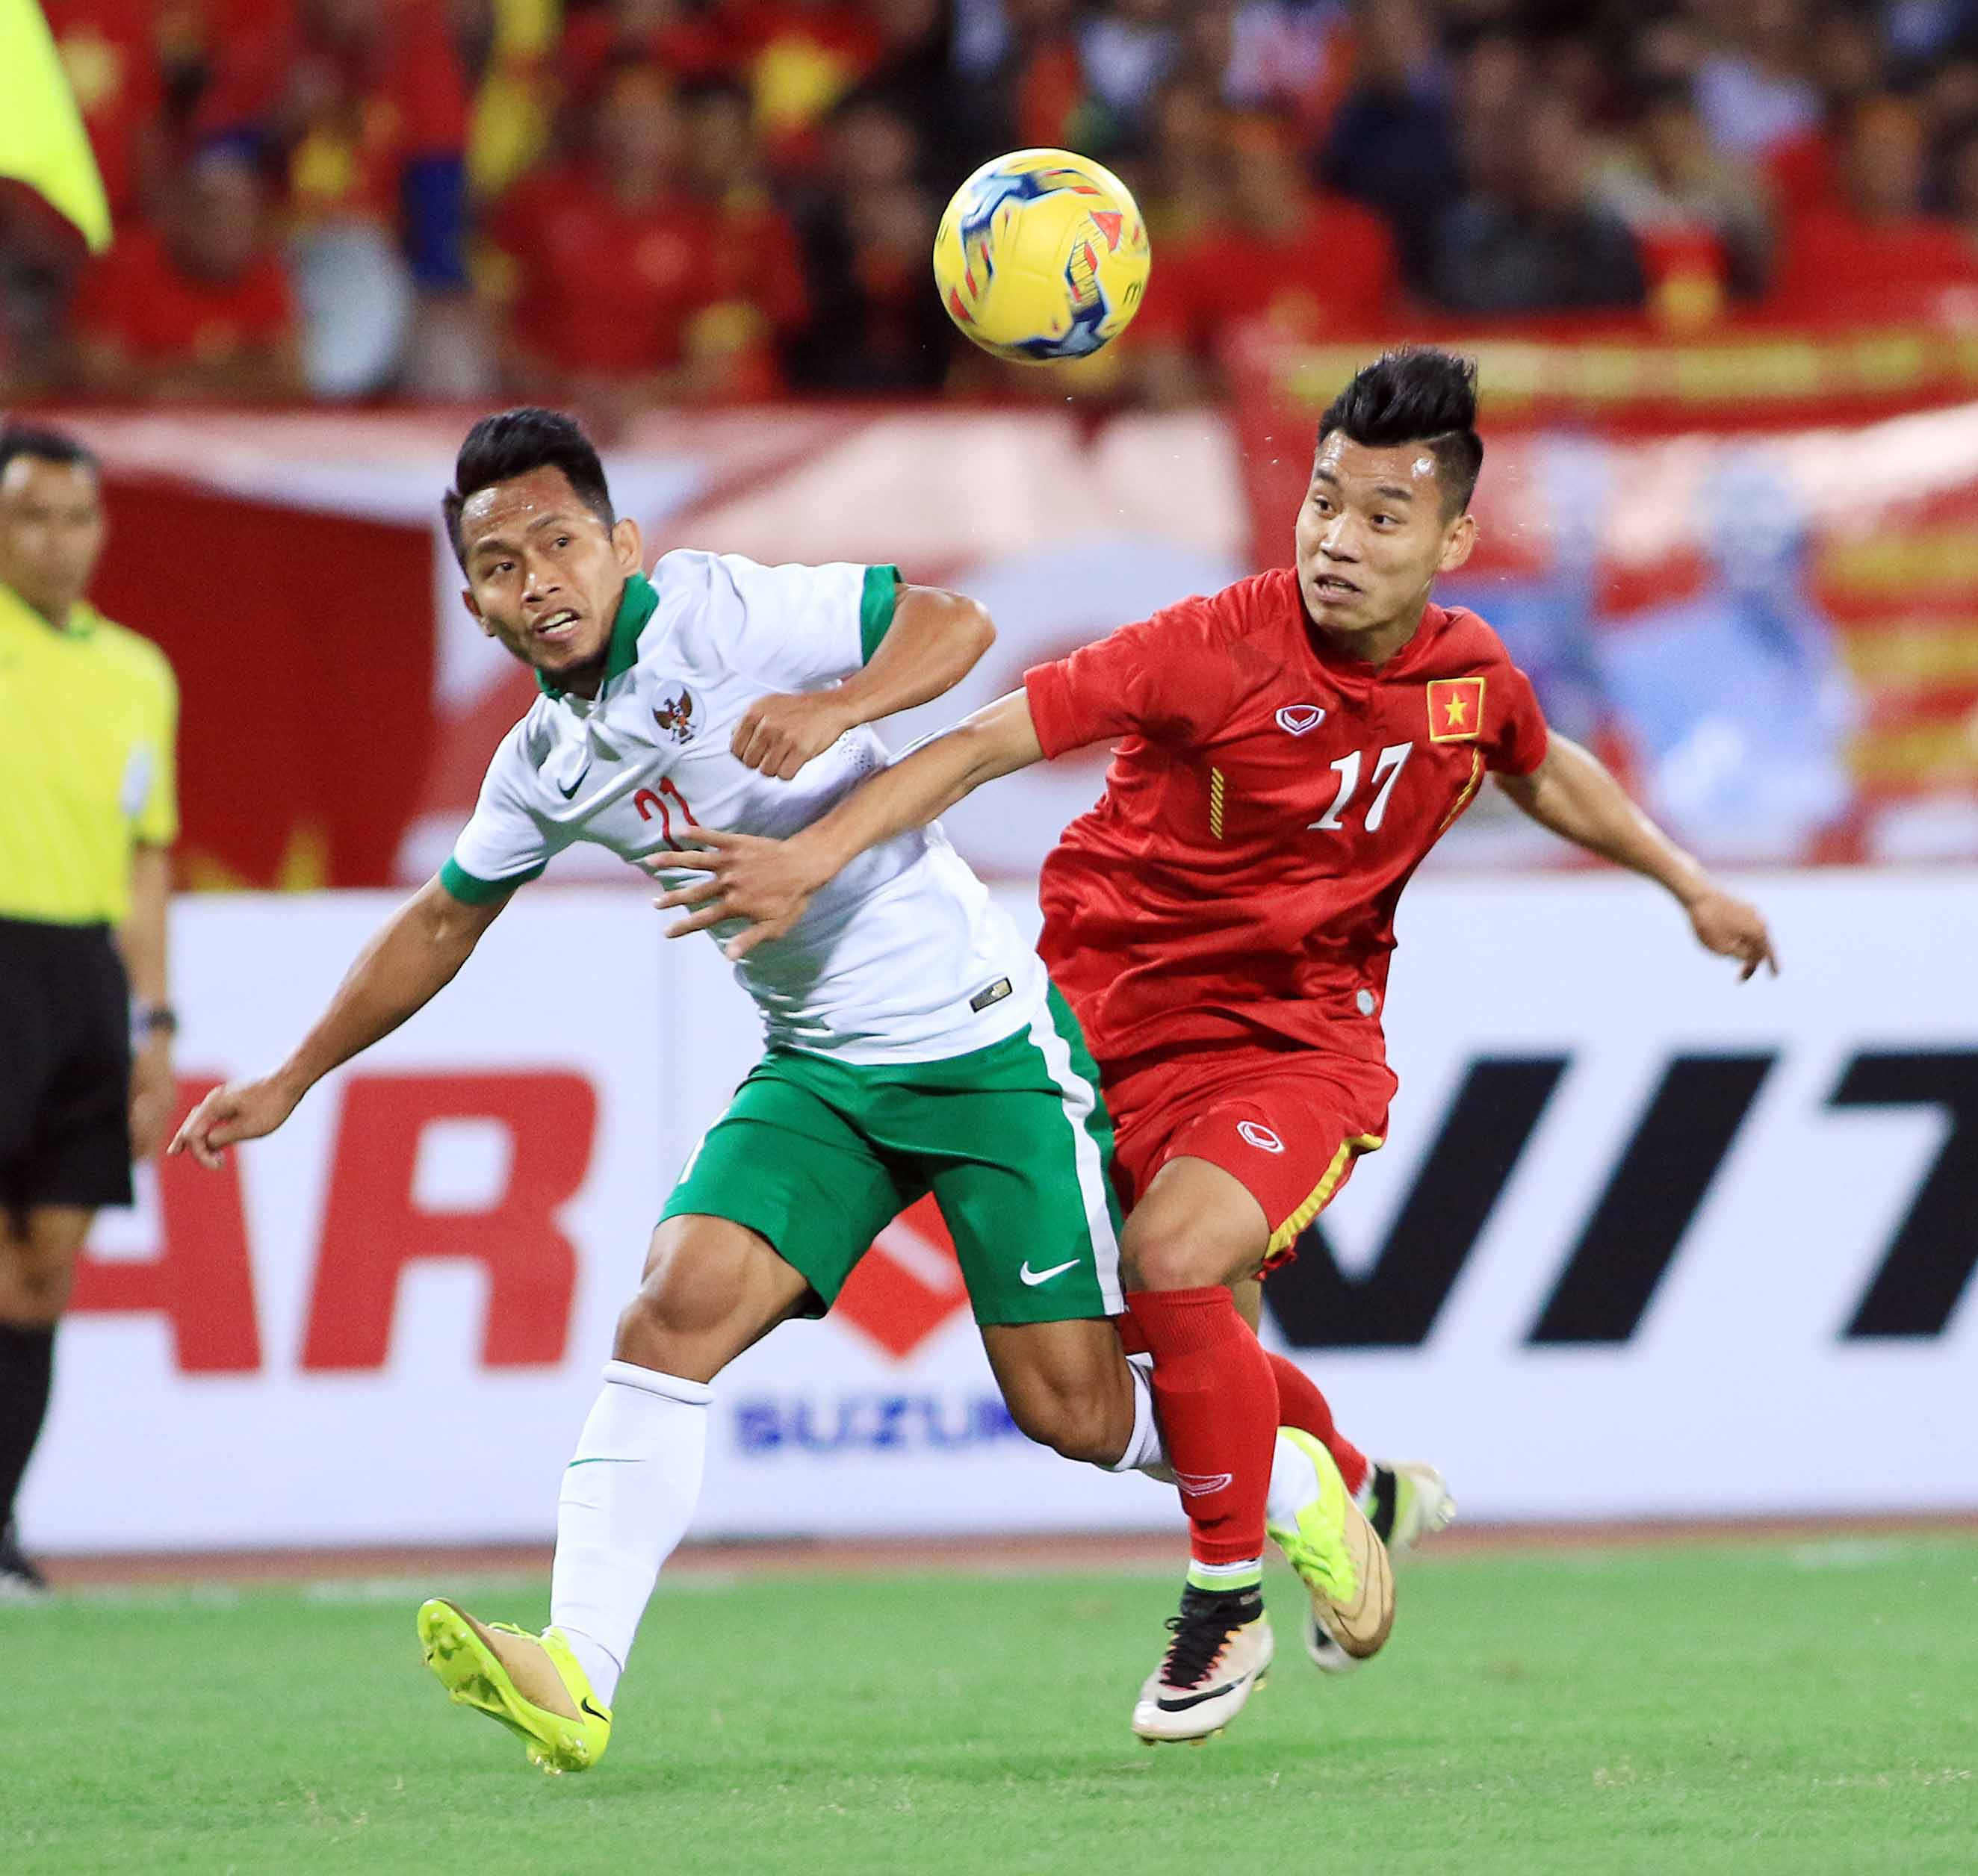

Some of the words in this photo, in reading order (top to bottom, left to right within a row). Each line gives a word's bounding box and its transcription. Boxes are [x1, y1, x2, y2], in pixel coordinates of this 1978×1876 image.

[633, 775, 700, 852] 21
[1306, 741, 1414, 833] 17
[734, 1395, 1020, 1449] SUZUK
